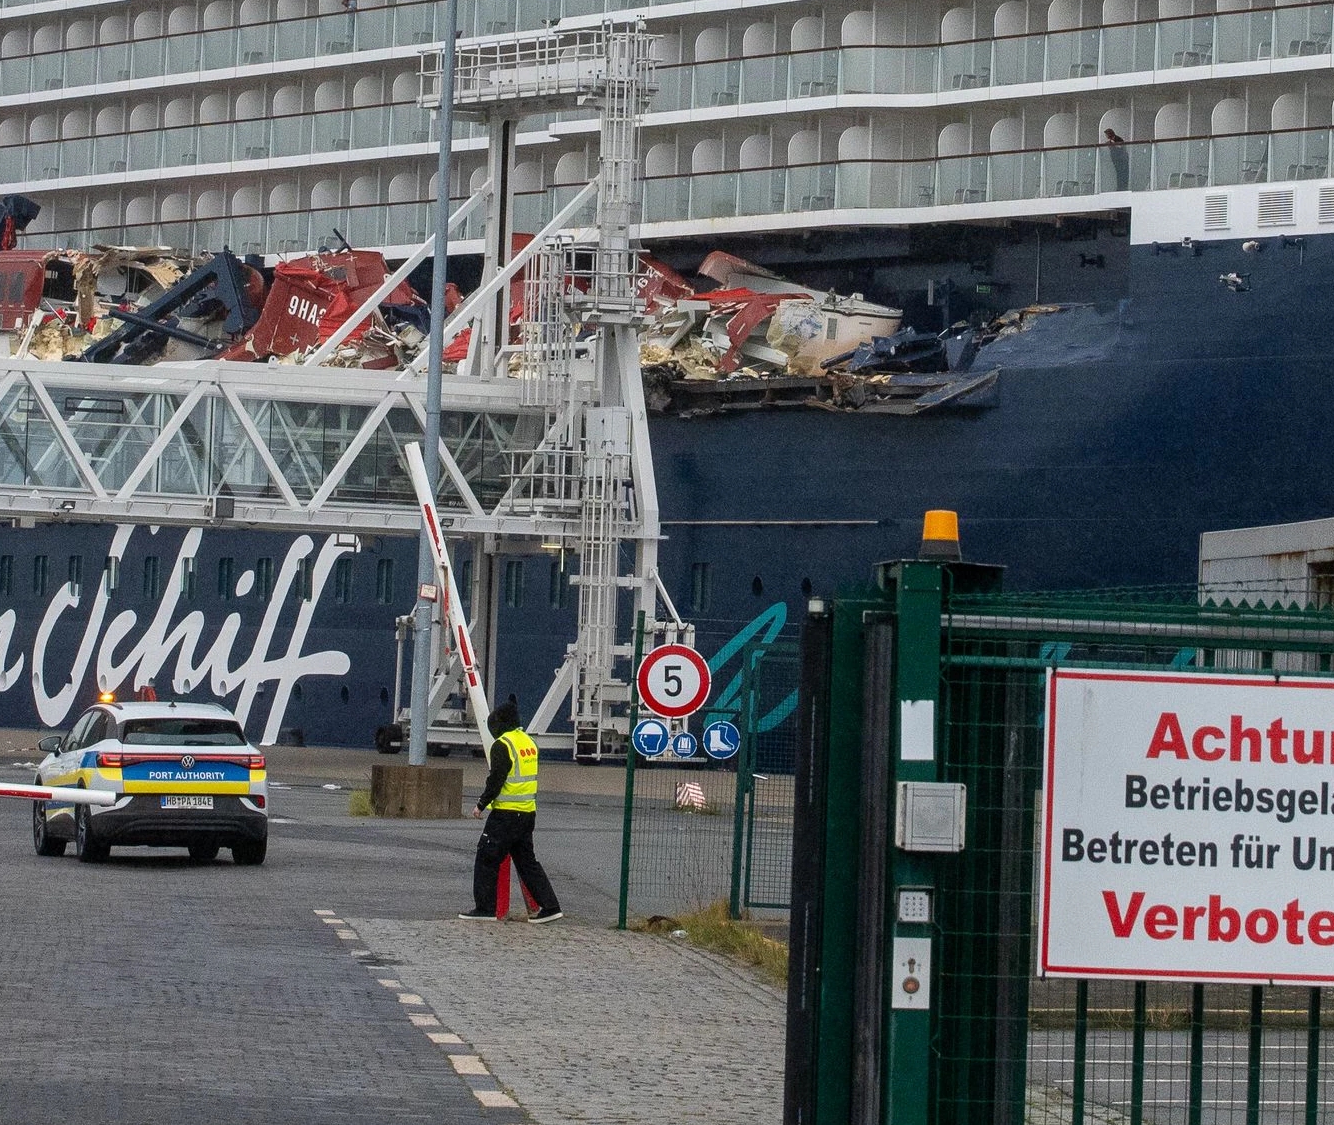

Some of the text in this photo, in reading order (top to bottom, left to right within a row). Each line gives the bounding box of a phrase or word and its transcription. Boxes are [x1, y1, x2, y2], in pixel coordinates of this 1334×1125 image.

[663, 665, 683, 697] 5
[149, 771, 225, 780] PORT AUTHORITY
[167, 797, 176, 806] HB
[1061, 828, 1218, 868] Betreten
[1230, 833, 1280, 870] für
